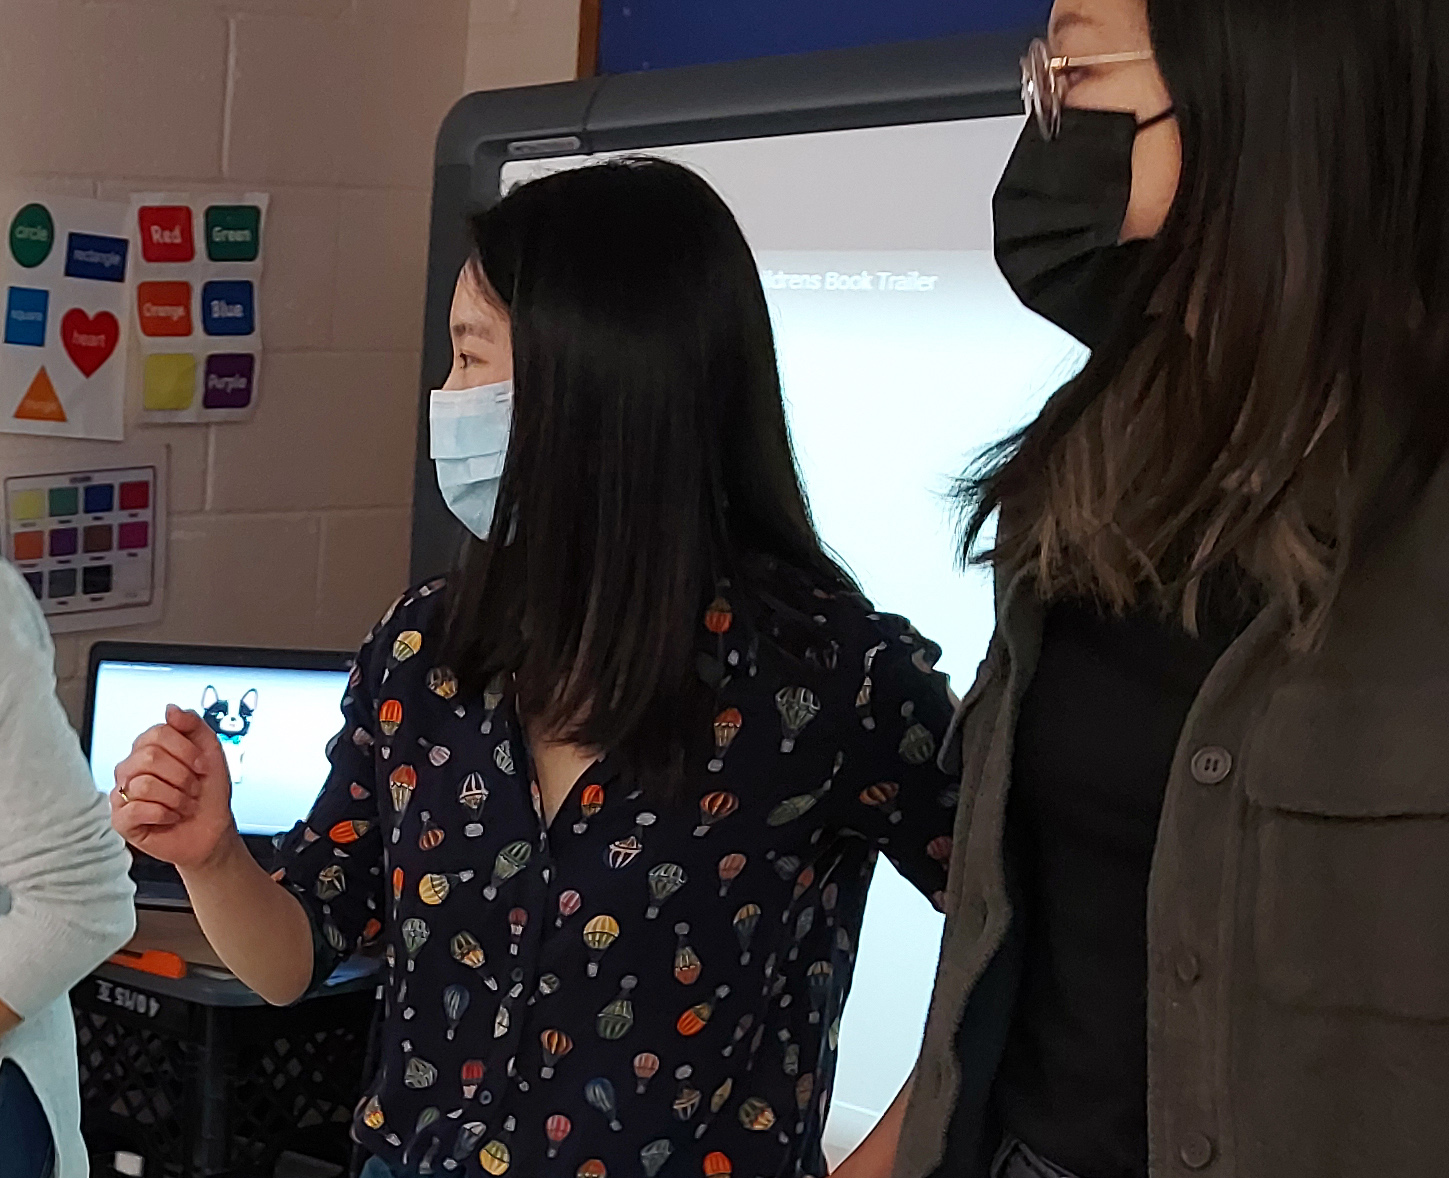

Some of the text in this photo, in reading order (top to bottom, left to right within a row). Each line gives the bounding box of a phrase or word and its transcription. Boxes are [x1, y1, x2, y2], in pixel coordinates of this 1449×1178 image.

[150, 225, 182, 244] Red
[212, 226, 251, 242] Green
[824, 270, 873, 290] Book
[876, 271, 938, 291] Trailer
[142, 302, 185, 321] Orange
[210, 300, 244, 318] Blue
[207, 373, 248, 393] Purple
